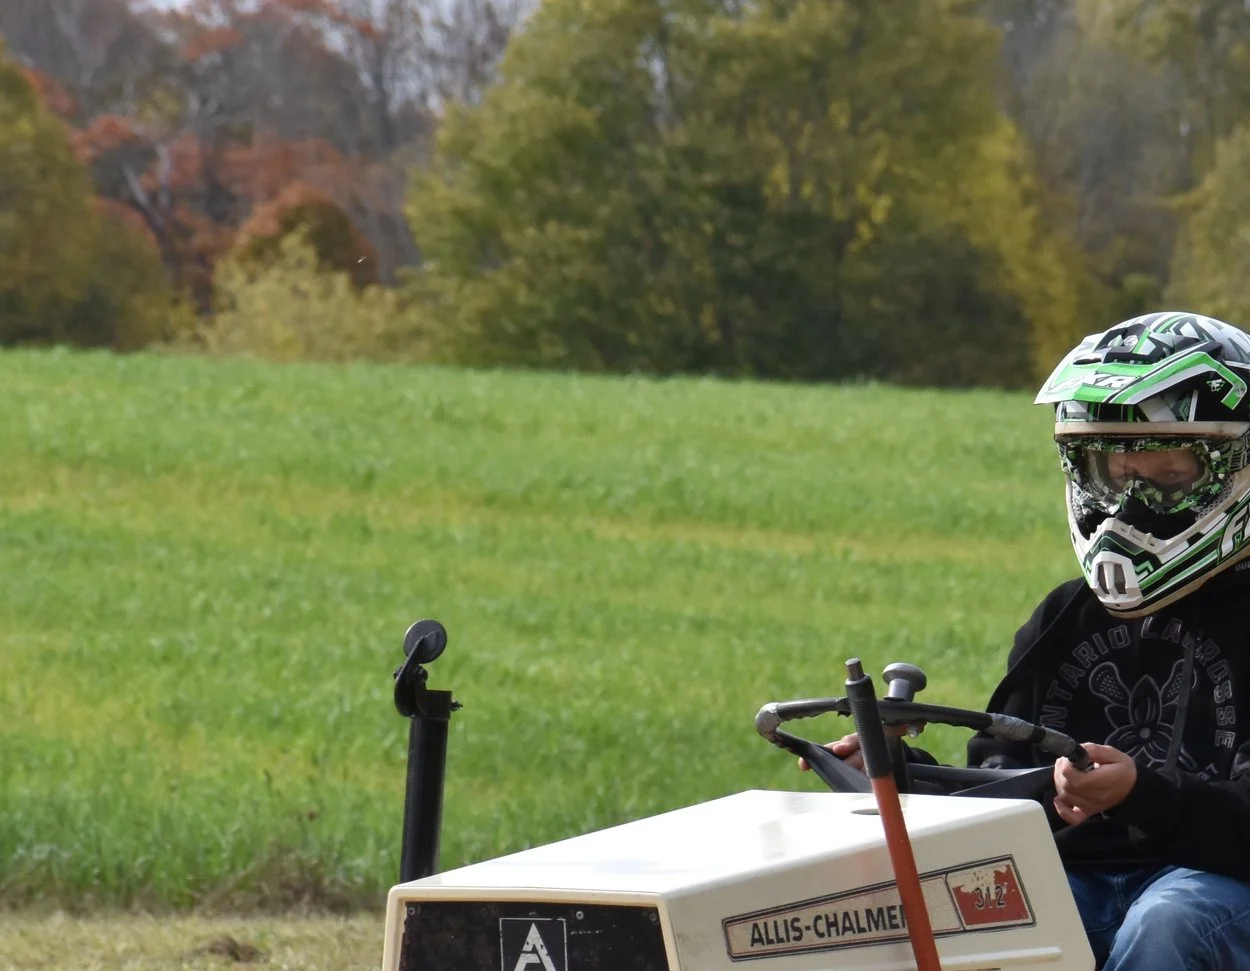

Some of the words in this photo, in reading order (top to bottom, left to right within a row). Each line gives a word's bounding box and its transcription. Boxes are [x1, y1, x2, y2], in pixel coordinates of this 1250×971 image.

[1037, 624, 1131, 732] NTARIO
[974, 885, 1006, 910] 312
[749, 904, 907, 948] ALLIS-CHALME
